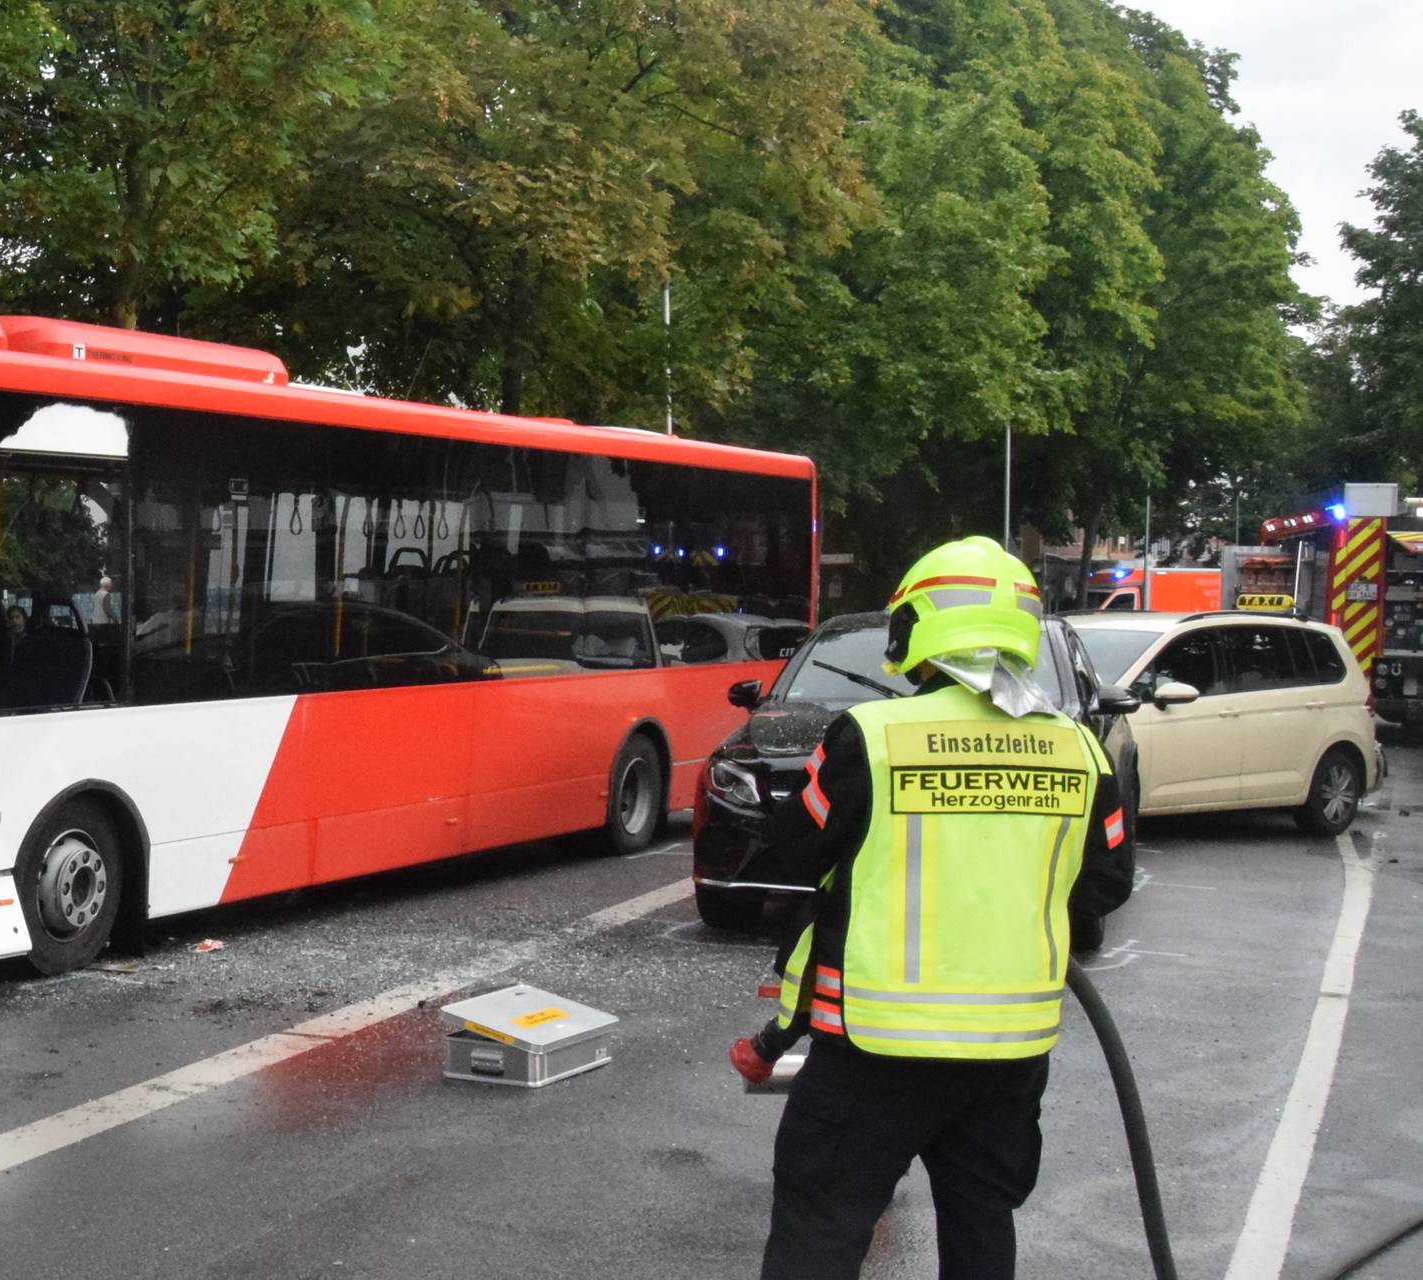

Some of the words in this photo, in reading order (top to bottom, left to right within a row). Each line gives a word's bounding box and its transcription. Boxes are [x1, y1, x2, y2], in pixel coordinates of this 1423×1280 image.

[1243, 596, 1280, 606] TAXI
[927, 733, 1054, 755] Einsatzleiter
[899, 772, 1082, 794] FEUERWEHR
[931, 791, 1060, 810] Herzogenrath
